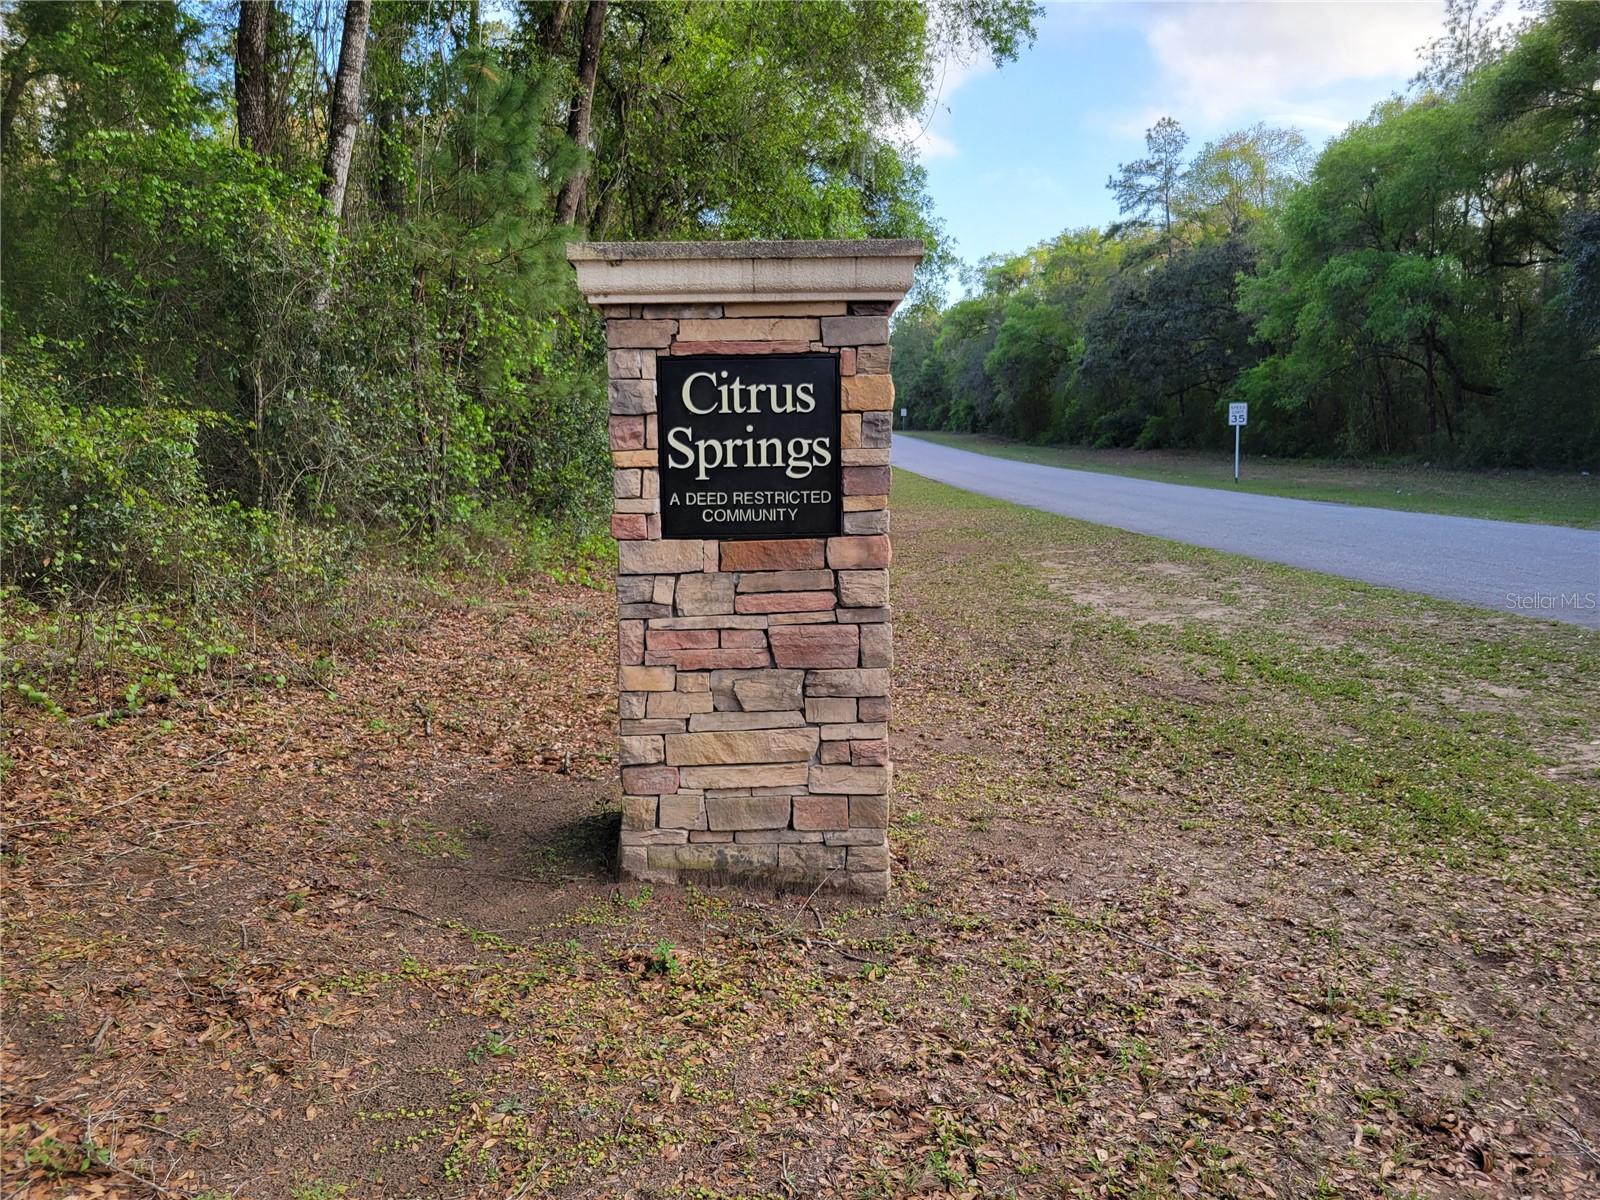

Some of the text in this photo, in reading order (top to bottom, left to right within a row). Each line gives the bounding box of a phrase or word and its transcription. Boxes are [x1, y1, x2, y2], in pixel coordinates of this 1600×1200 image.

[681, 370, 816, 415] Citrus
[1231, 415, 1245, 423] 35
[667, 424, 832, 481] Springs
[669, 490, 832, 506] A DEED RESTRICTED
[702, 508, 799, 523] COMMUNITY
